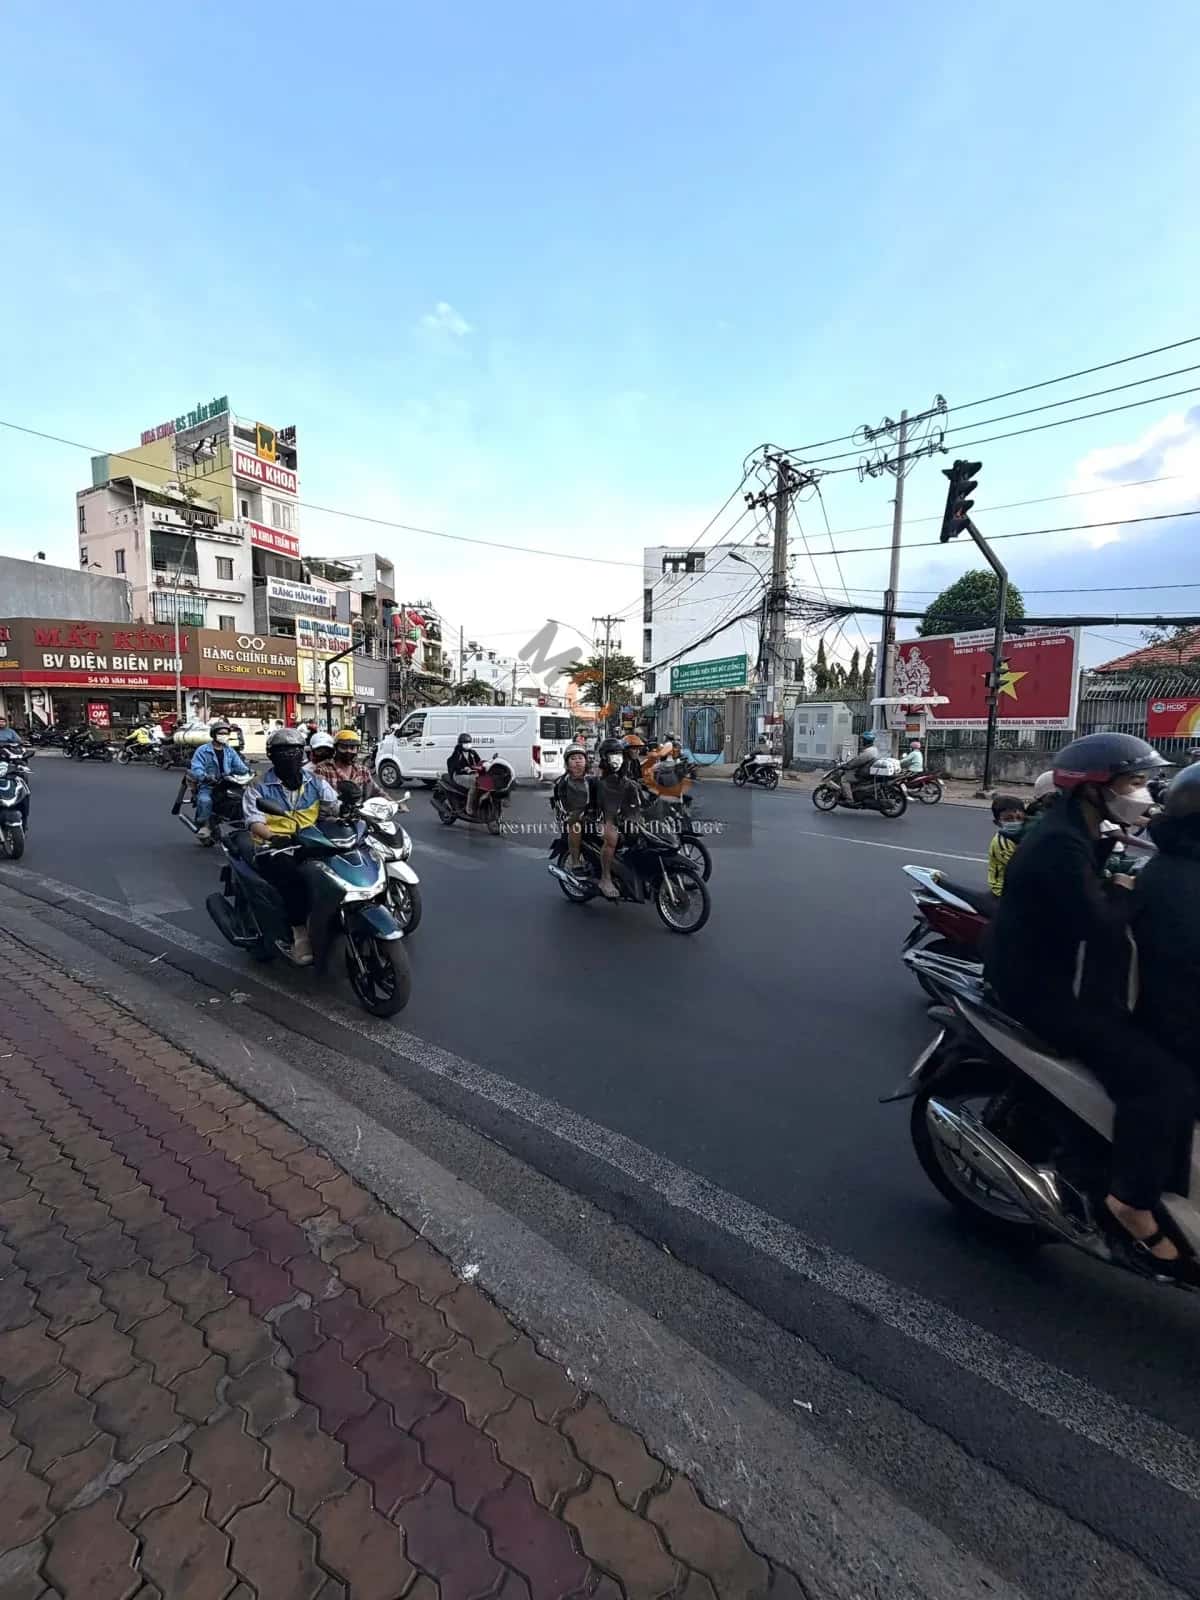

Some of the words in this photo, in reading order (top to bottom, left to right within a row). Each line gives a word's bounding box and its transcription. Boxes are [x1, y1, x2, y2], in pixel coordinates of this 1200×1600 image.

[175, 415, 186, 432] BS
[238, 454, 263, 479] NHA
[265, 465, 296, 490] KHOA
[42, 653, 65, 669] BV
[69, 651, 108, 672] ĐIỆN
[112, 653, 149, 672] BIÊN
[235, 649, 268, 664] CHÍNH
[88, 676, 99, 684] 54
[92, 710, 107, 718] OFF
[1167, 703, 1187, 711] HCDC
